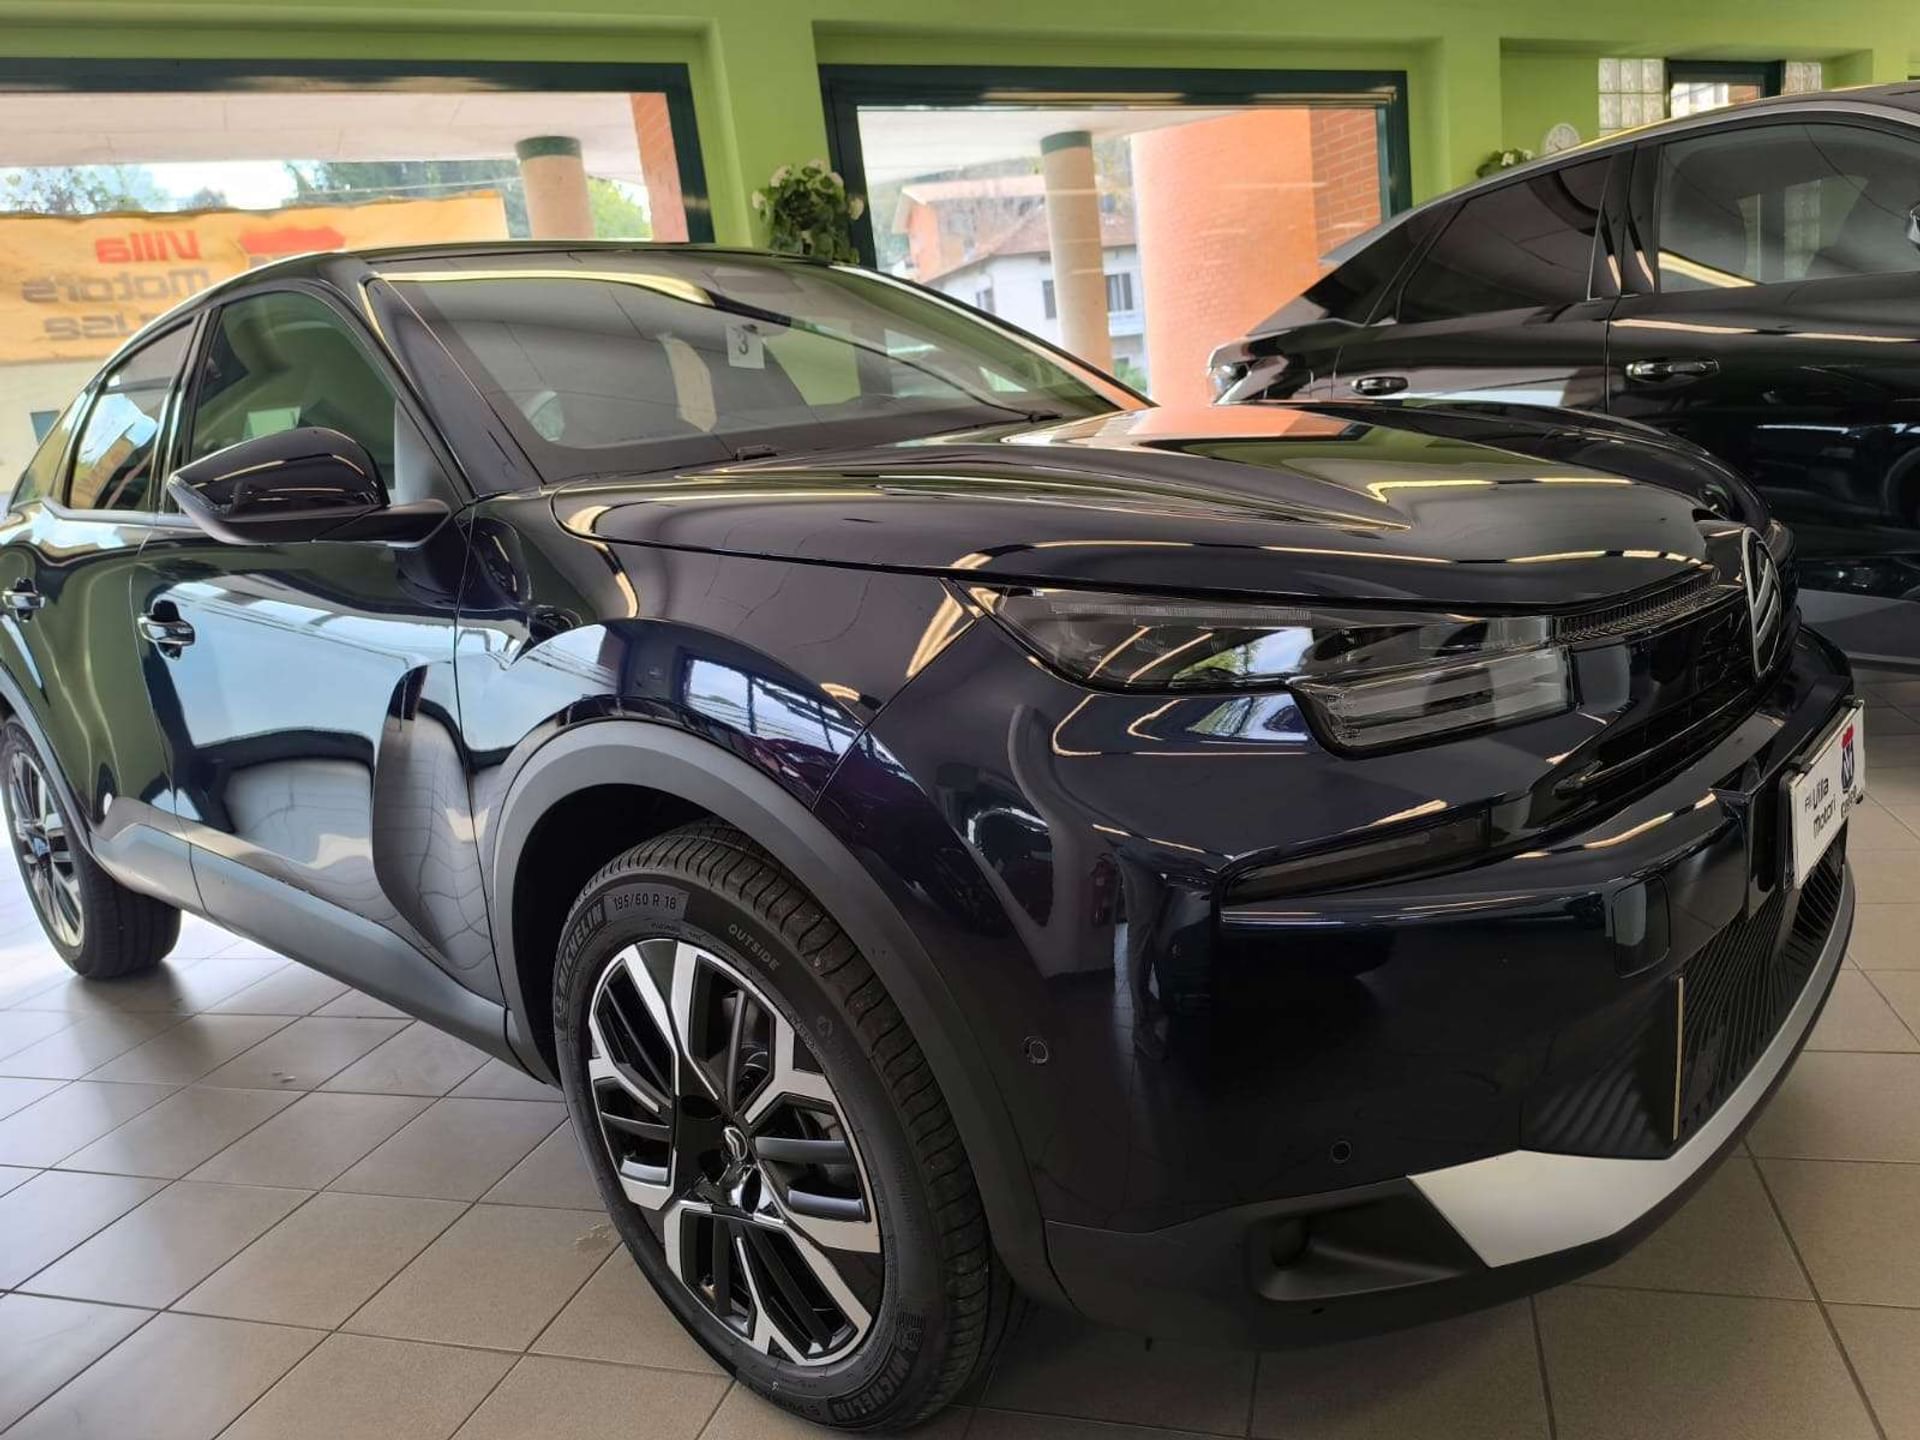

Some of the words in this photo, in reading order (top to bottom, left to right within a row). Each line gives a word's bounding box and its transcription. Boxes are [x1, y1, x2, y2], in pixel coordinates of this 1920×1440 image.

[613, 893, 649, 912] 195/60
[652, 895, 661, 907] R
[665, 895, 677, 910] 18
[727, 923, 780, 972] OUTSIDE
